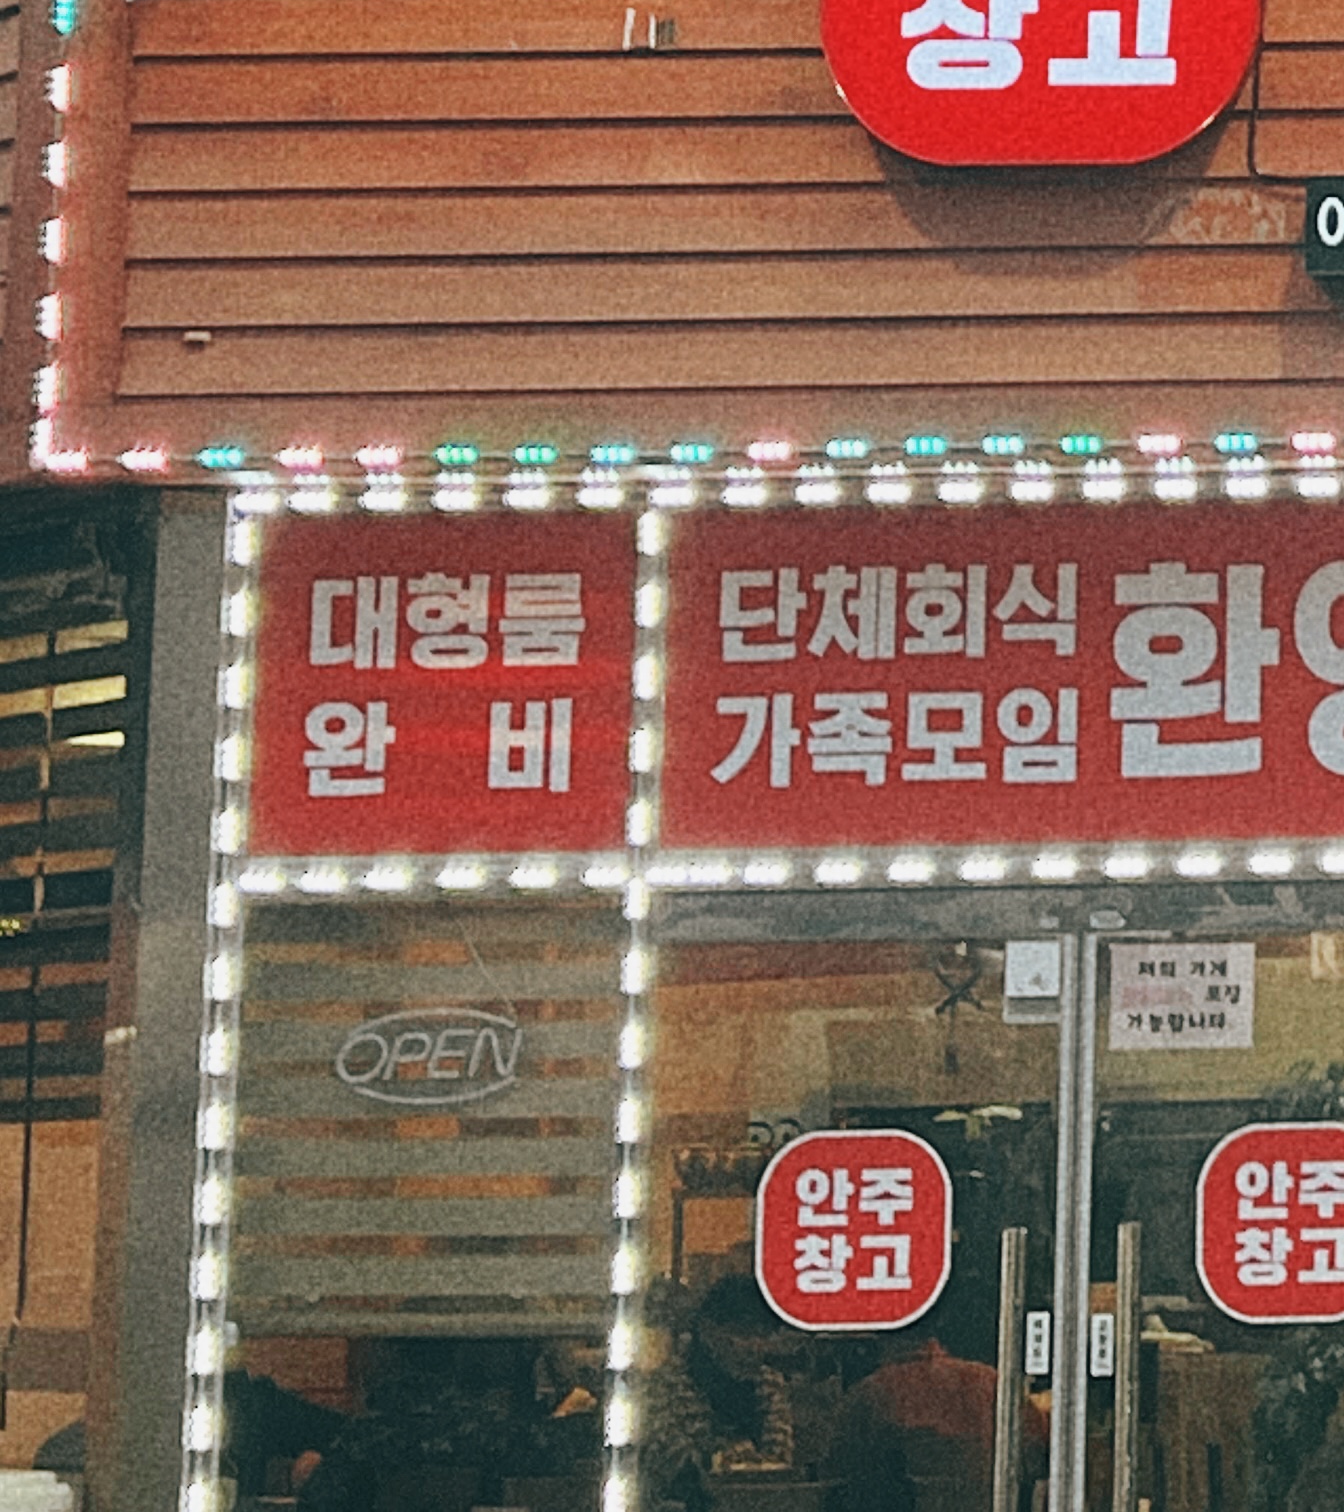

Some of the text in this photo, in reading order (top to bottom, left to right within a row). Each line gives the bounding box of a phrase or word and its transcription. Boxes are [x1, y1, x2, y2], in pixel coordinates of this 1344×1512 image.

[309, 572, 586, 670] 대형룸
[718, 563, 1078, 663] 단체회식
[710, 688, 1079, 788] 가족모임
[335, 1027, 524, 1084] OPEN
[795, 1167, 914, 1227] 안주
[793, 1233, 912, 1293] 창고
